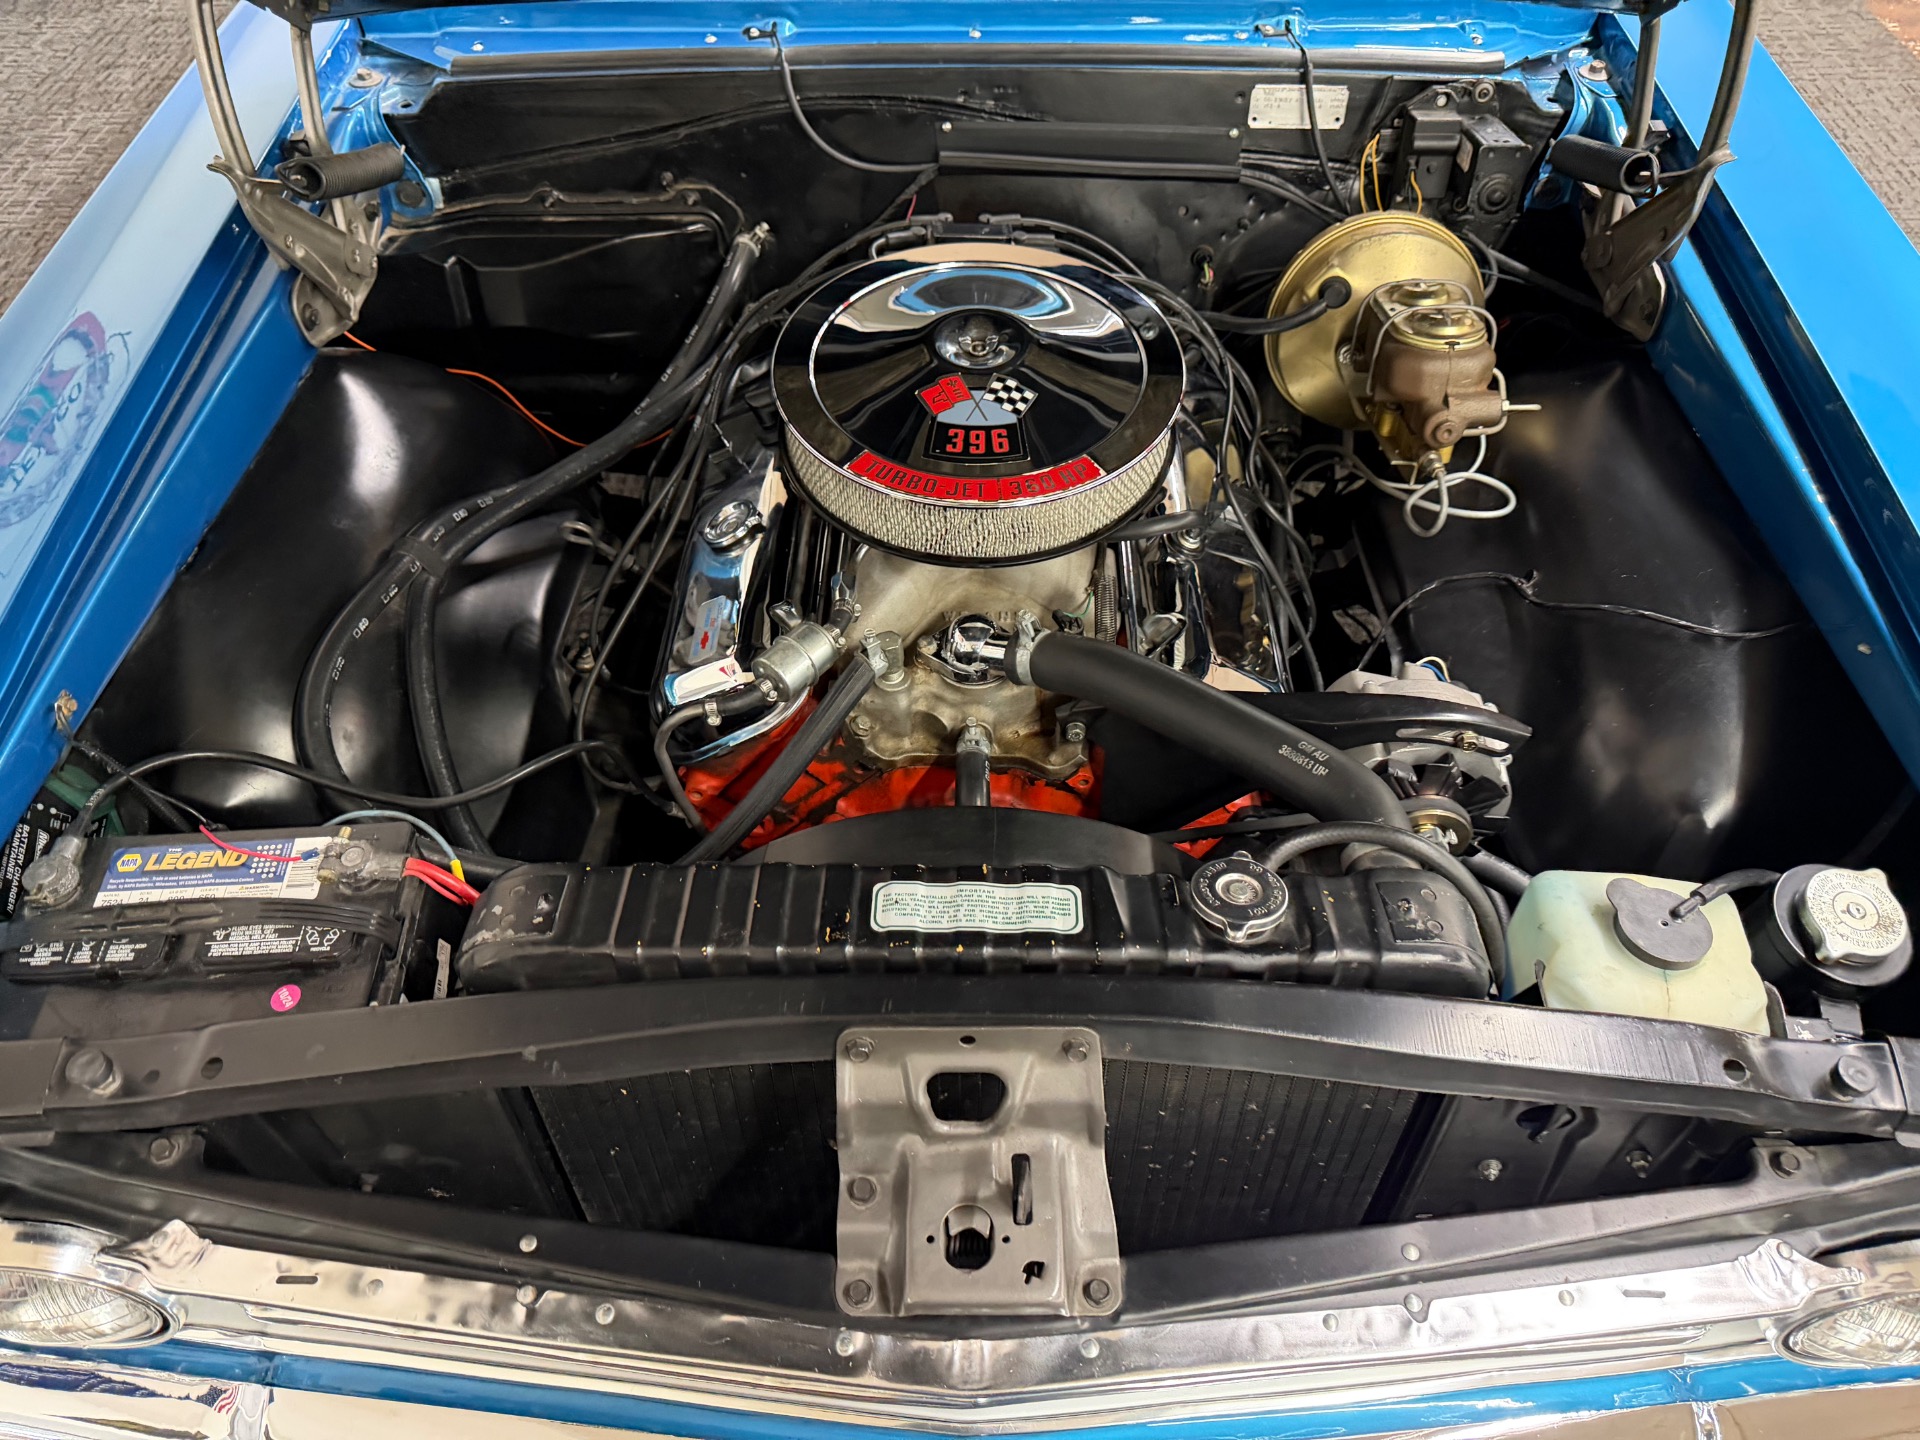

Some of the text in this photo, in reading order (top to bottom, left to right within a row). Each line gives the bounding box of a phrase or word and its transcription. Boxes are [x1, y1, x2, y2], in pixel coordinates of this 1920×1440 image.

[946, 428, 1010, 454] 396
[863, 459, 985, 498] TURBO-JET
[1060, 463, 1087, 485] HP
[1298, 741, 1330, 762] GM AU
[5, 823, 22, 879] MAINTAINER
[120, 850, 249, 871] NAPA LEGEND
[6, 824, 30, 914] BATTERY CHARGER/
